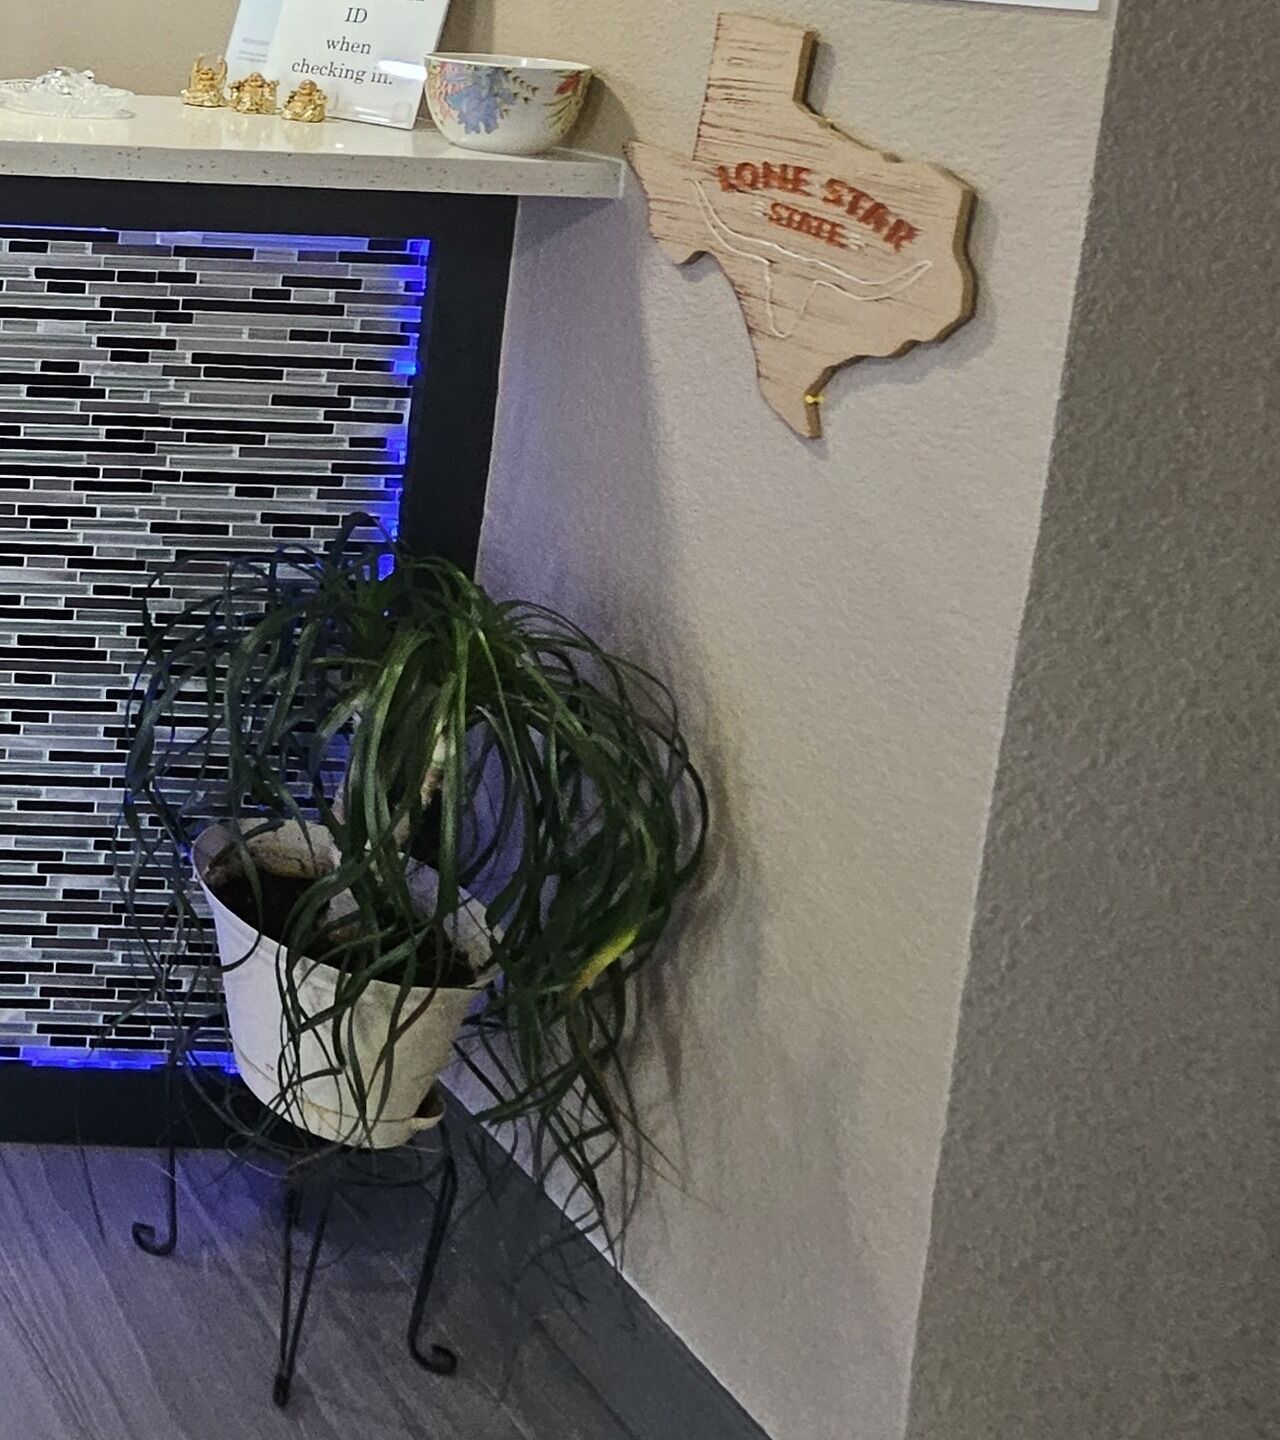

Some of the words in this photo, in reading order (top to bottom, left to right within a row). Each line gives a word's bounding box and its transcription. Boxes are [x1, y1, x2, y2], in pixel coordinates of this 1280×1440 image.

[345, 8, 368, 24] ID
[326, 37, 372, 55] when
[292, 59, 366, 84] checking
[371, 72, 393, 85] in.
